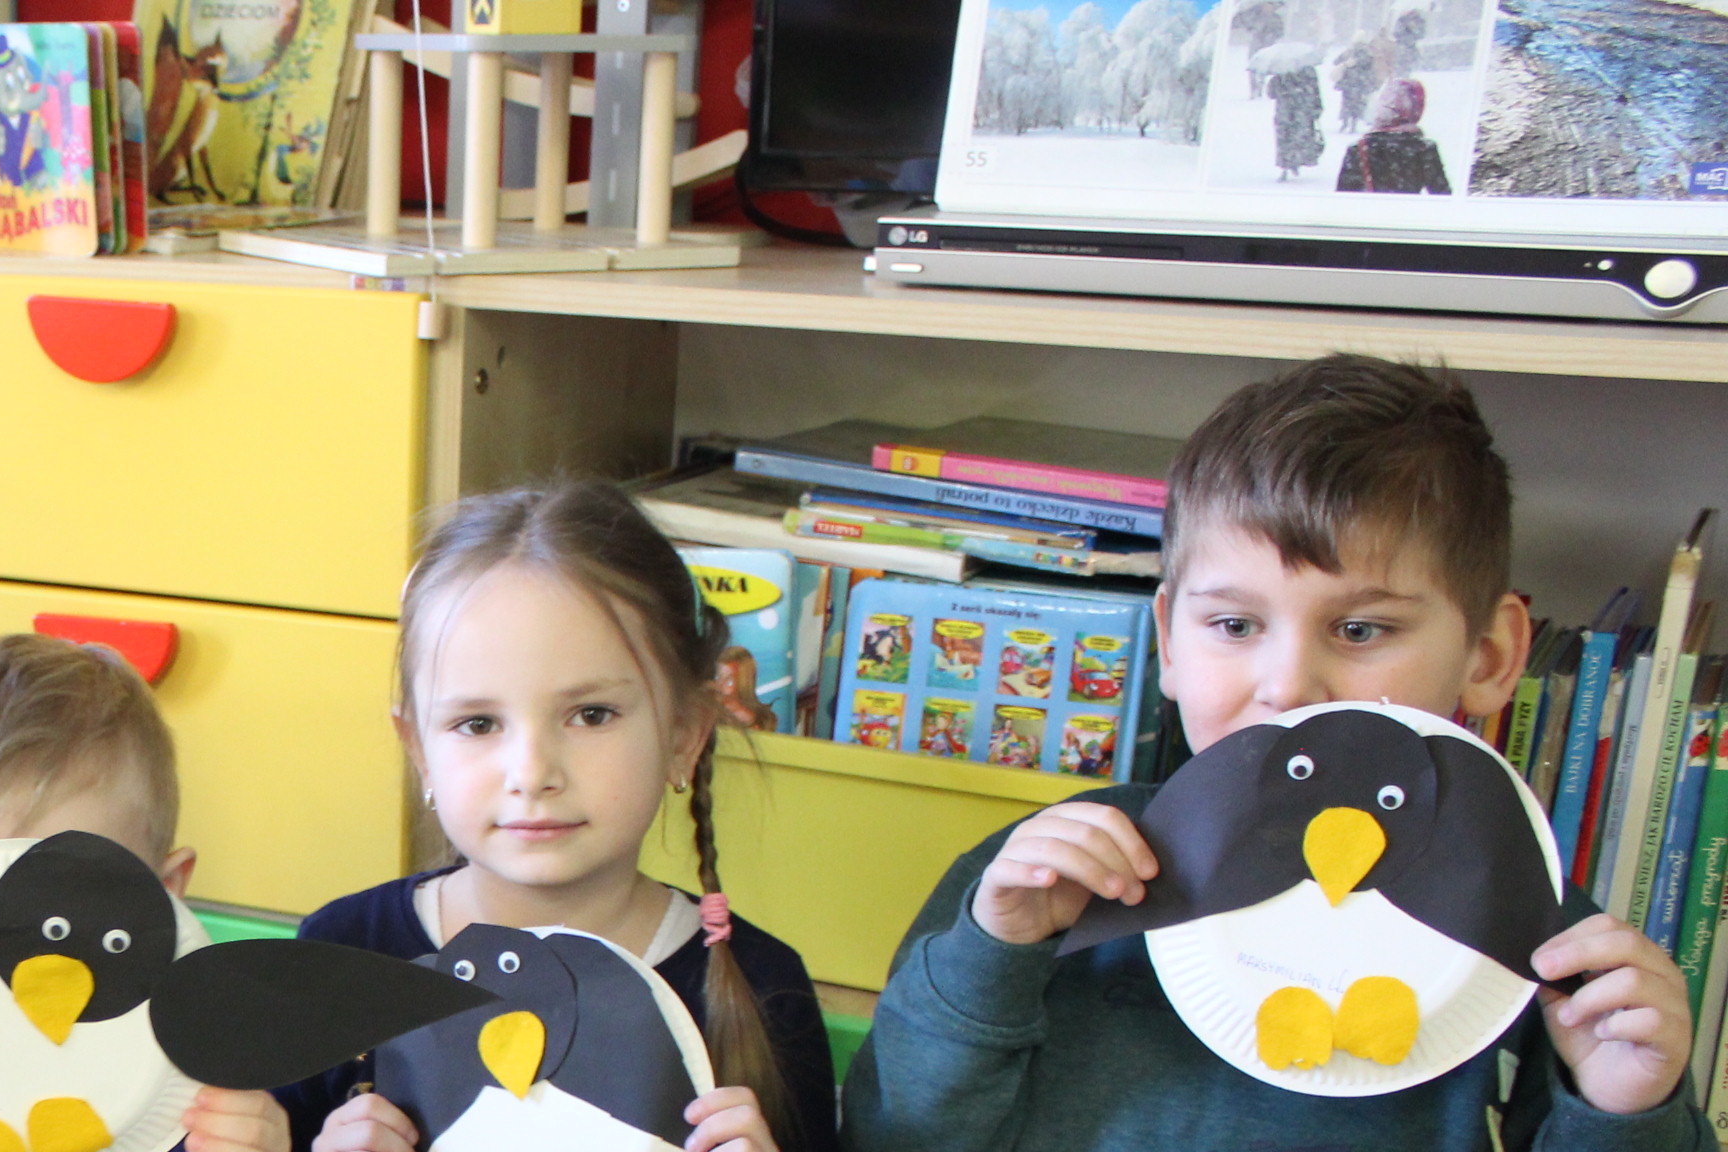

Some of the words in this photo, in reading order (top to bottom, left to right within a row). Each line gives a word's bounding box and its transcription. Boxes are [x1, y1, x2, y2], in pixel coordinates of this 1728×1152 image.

[965, 151, 988, 168] 55
[908, 230, 928, 243] LG
[994, 494, 1009, 509] to
[1015, 497, 1081, 522] dziecko
[697, 576, 748, 594] NKA
[1573, 731, 1588, 751] NA
[1645, 826, 1659, 848] JAK
[1664, 699, 1685, 753] KOCHAM
[1679, 916, 1711, 977] Księga
